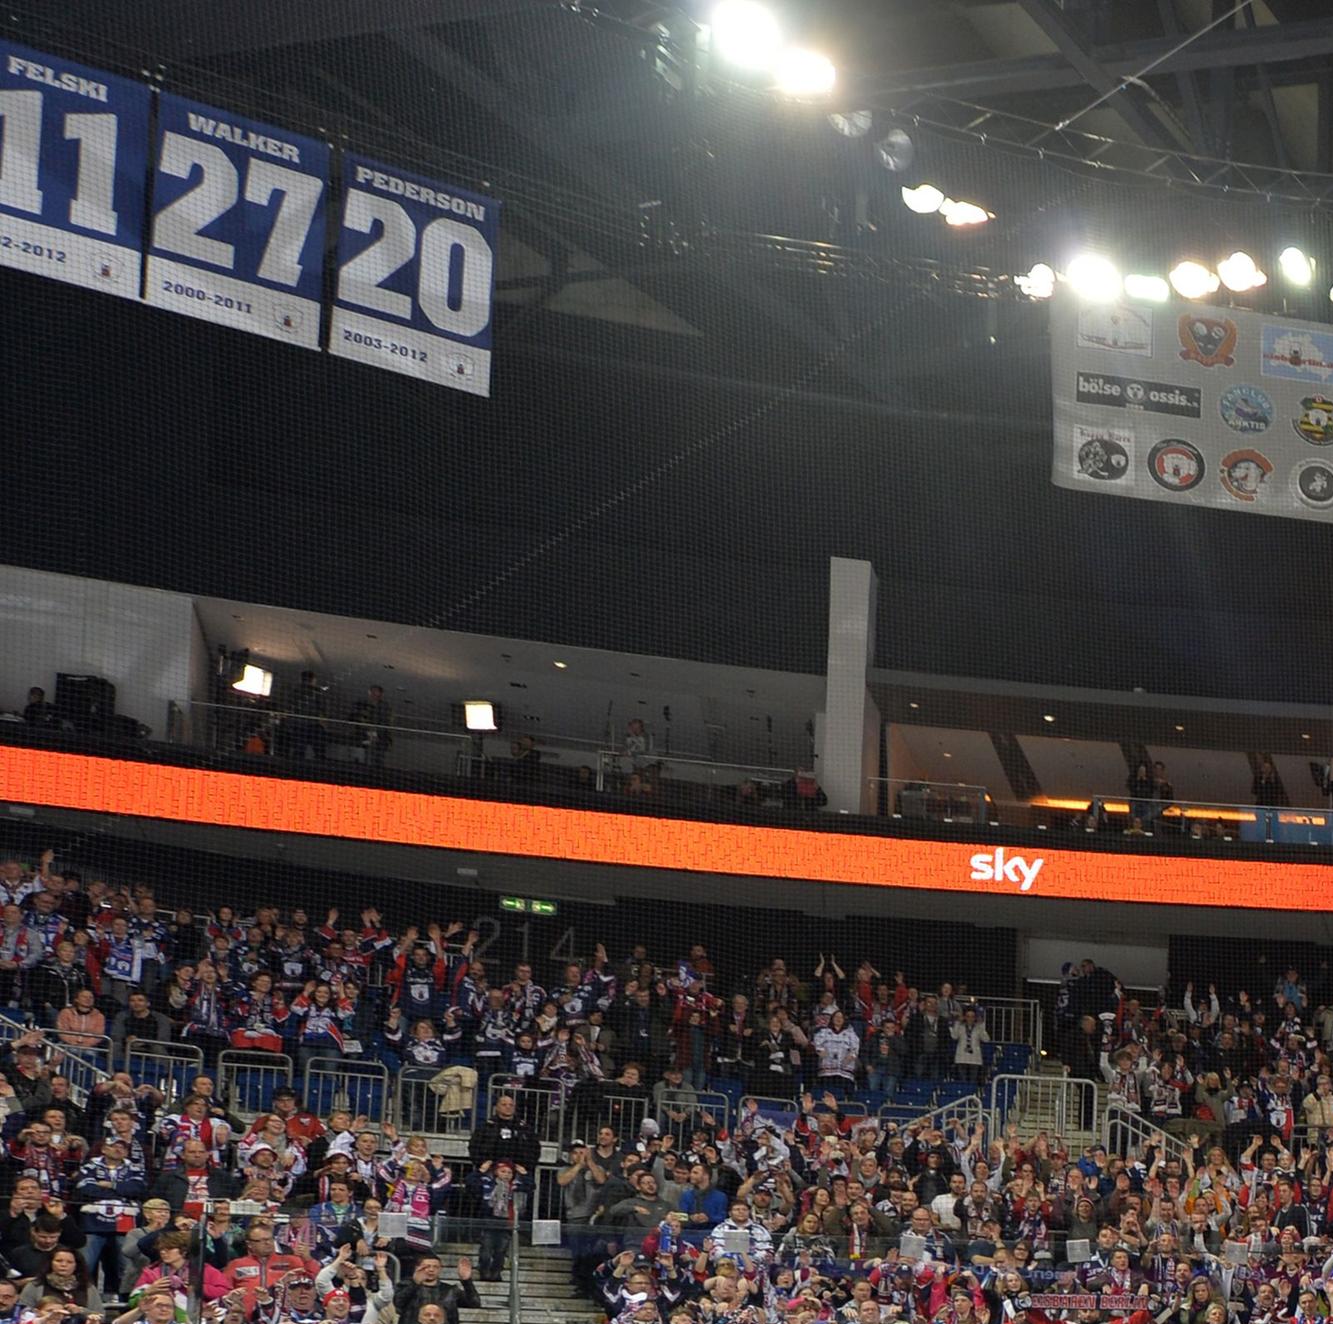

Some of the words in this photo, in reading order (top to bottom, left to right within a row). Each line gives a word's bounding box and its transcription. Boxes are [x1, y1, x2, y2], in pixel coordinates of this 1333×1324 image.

[8, 55, 108, 103] FELSKI
[186, 111, 300, 164] WALKER
[151, 131, 324, 288] 27
[355, 166, 486, 222] PEDERSON
[2, 236, 67, 264] 2-2012
[336, 187, 494, 338] 20
[162, 280, 253, 316] 2000-2011
[342, 329, 429, 363] 2003-2012
[969, 847, 1044, 892] sky
